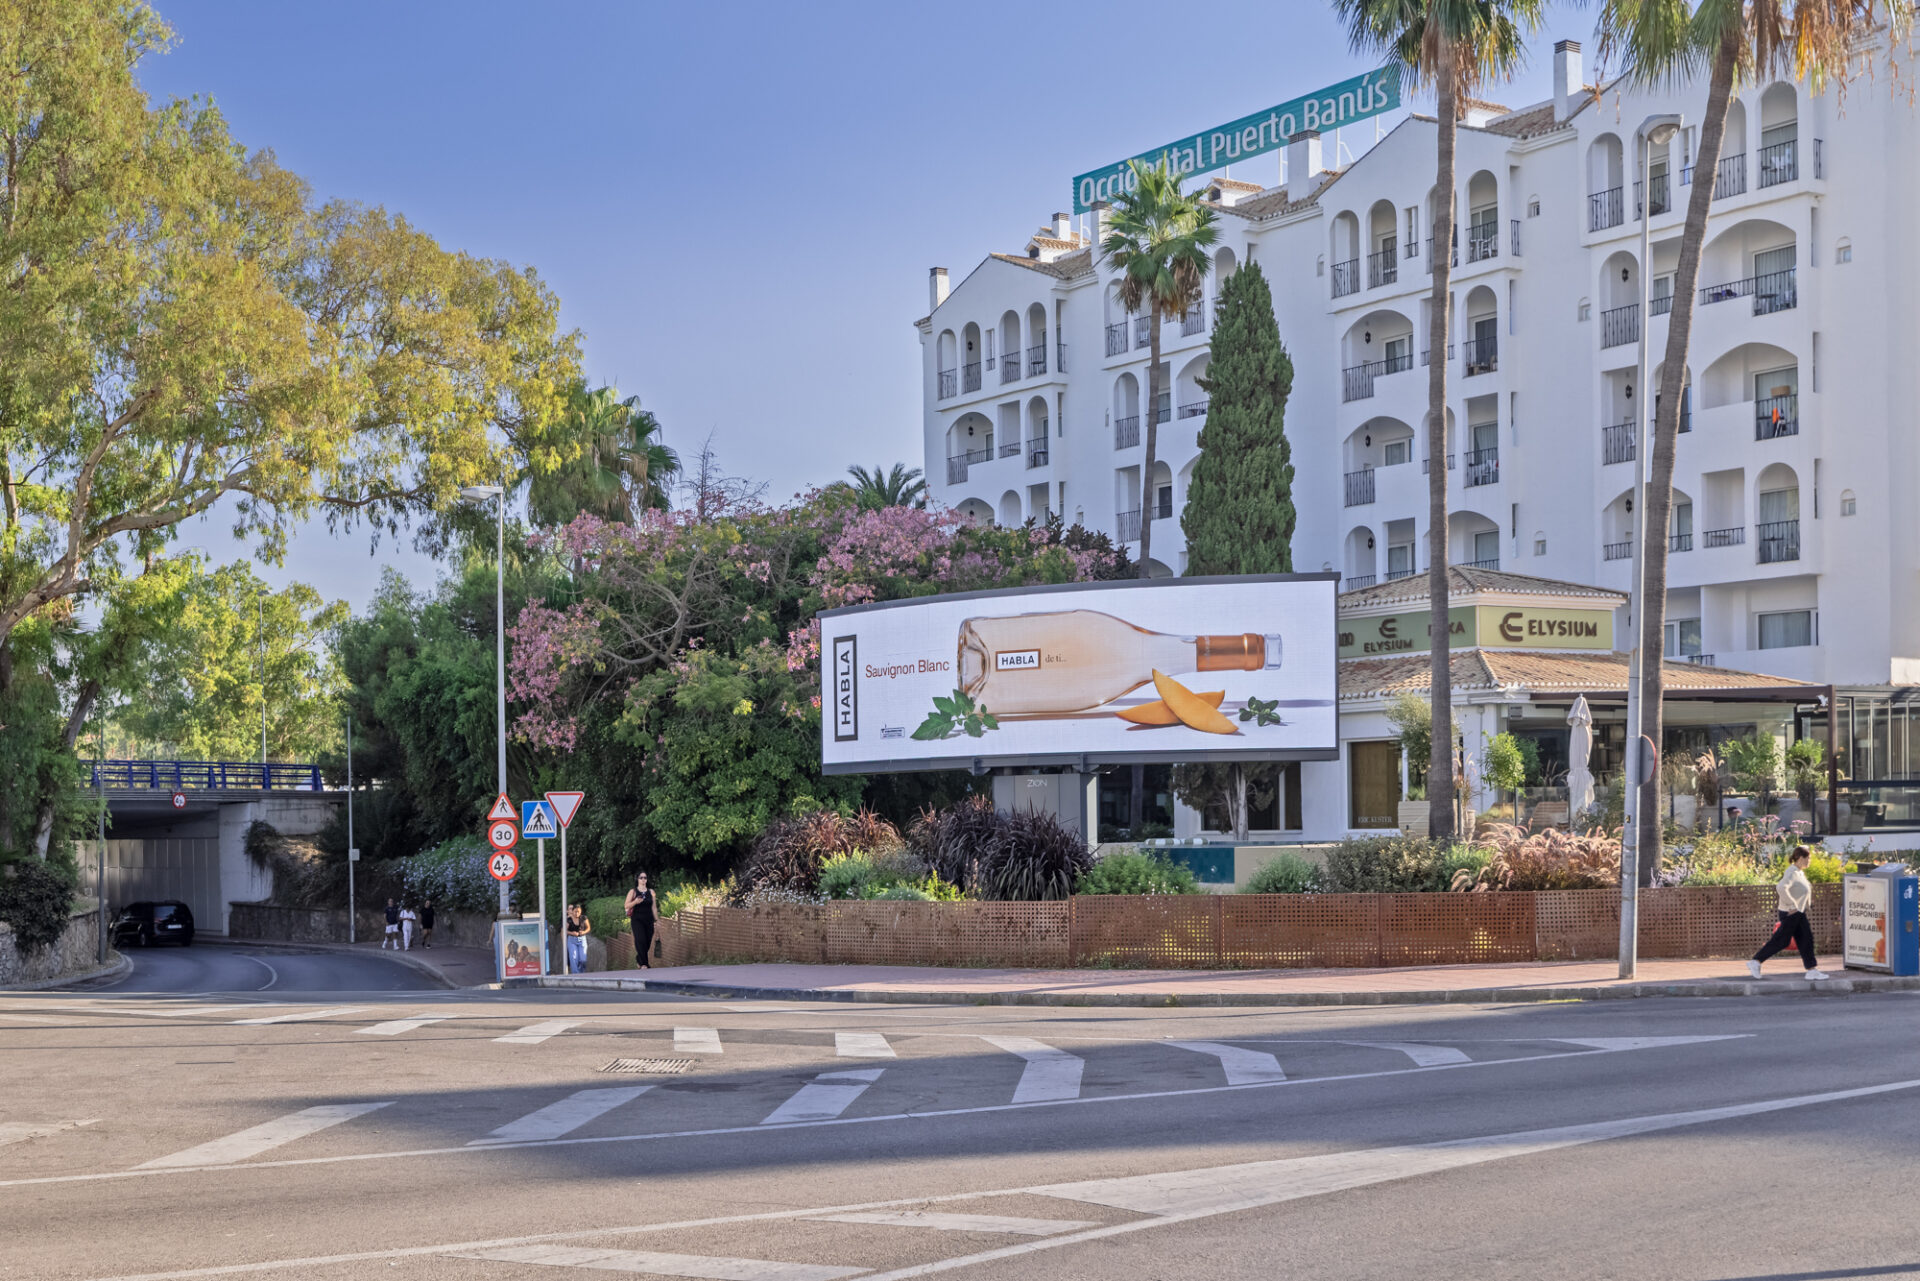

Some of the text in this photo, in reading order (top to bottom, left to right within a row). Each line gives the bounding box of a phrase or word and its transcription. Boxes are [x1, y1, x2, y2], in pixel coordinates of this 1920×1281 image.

[1211, 112, 1296, 165] Puerto
[1303, 74, 1389, 131] Banús
[1528, 619, 1597, 637] ELYSIUM
[1363, 639, 1414, 653] ELYSIUM
[1002, 655, 1035, 666] HABLA
[865, 659, 950, 679] Sauvignon Blanc
[840, 650, 851, 725] HABLA
[1027, 779, 1048, 788] ZION
[495, 830, 512, 840] 30
[1849, 901, 1875, 910] ESPACIO
